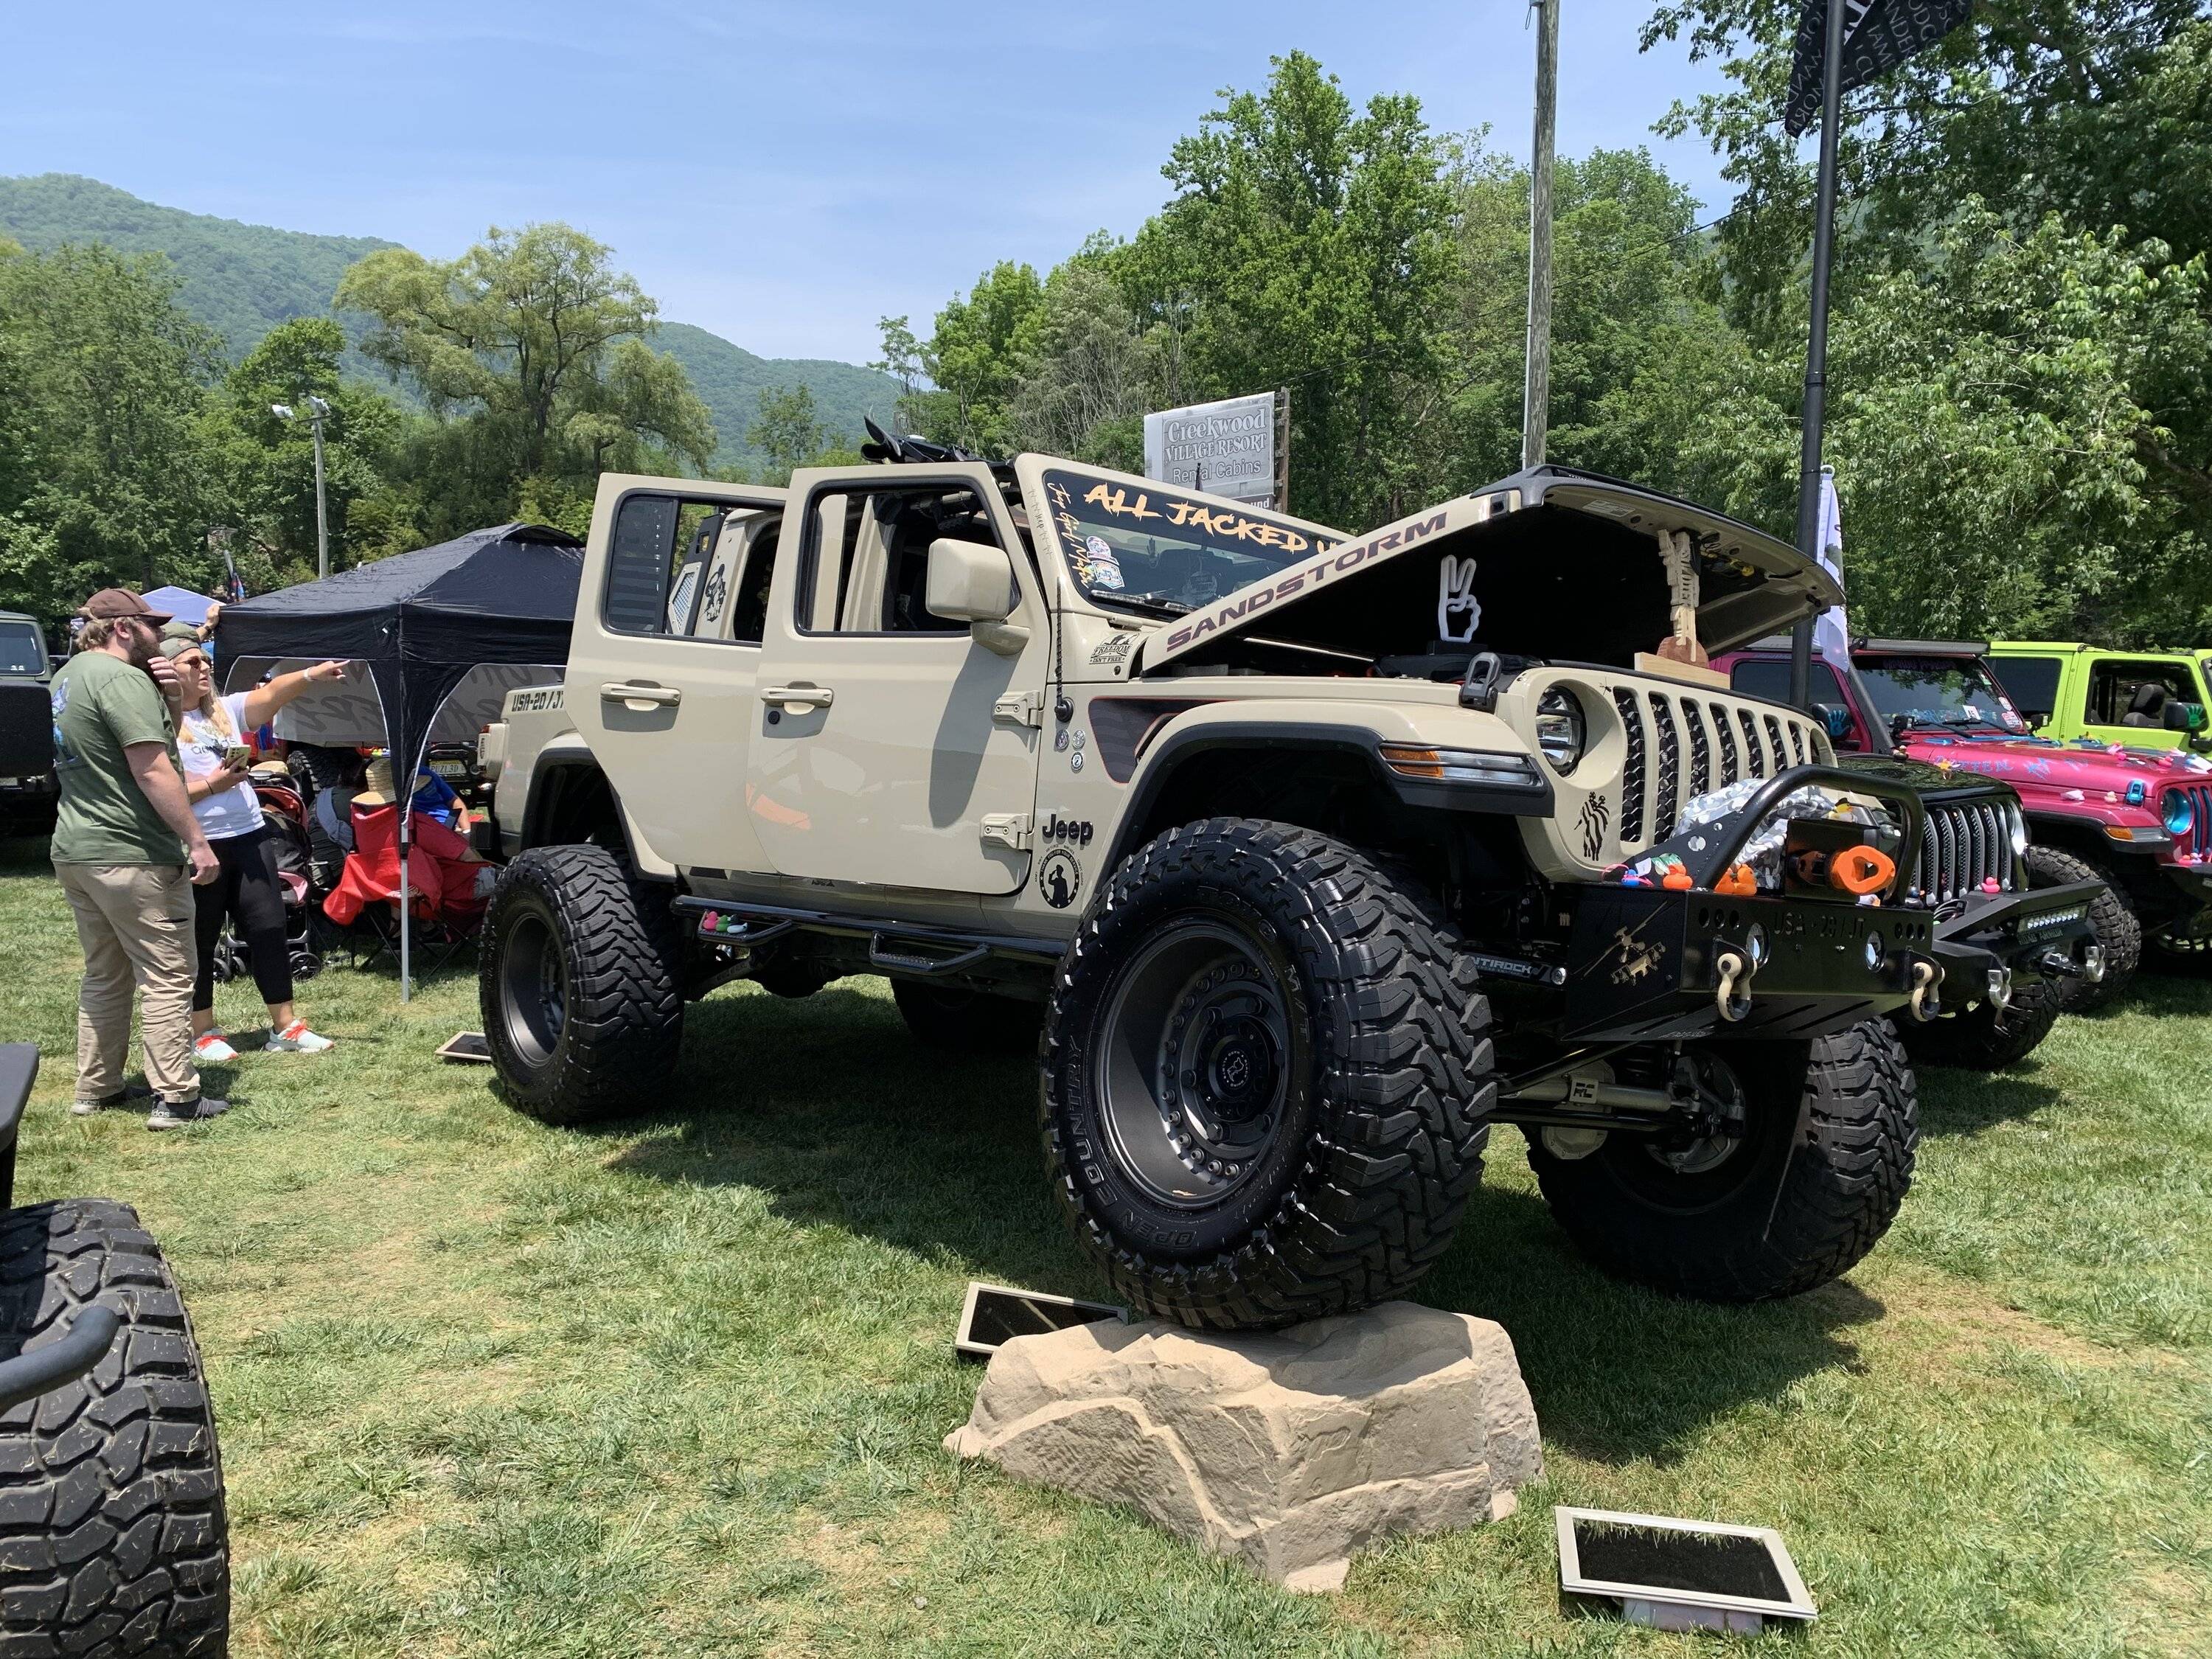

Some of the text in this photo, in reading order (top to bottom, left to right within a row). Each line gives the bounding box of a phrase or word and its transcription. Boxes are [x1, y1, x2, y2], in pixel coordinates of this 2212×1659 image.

[1168, 407, 1267, 442] Creekwood
[1165, 433, 1267, 463] VILLAGE RESORT
[1173, 459, 1262, 484] Renal Cabins
[1047, 481, 1071, 509] Jeep
[1057, 511, 1085, 550] Girl
[1085, 484, 1163, 521] ALL
[1166, 501, 1309, 554] JACKED
[1166, 512, 1447, 653] SANDSTORM
[1091, 643, 1133, 656] FREEDOM
[1042, 813, 1093, 845] Jeep
[1475, 957, 1532, 974] NTIROCK
[1065, 1034, 1198, 1251] OPEN COUNTRY
